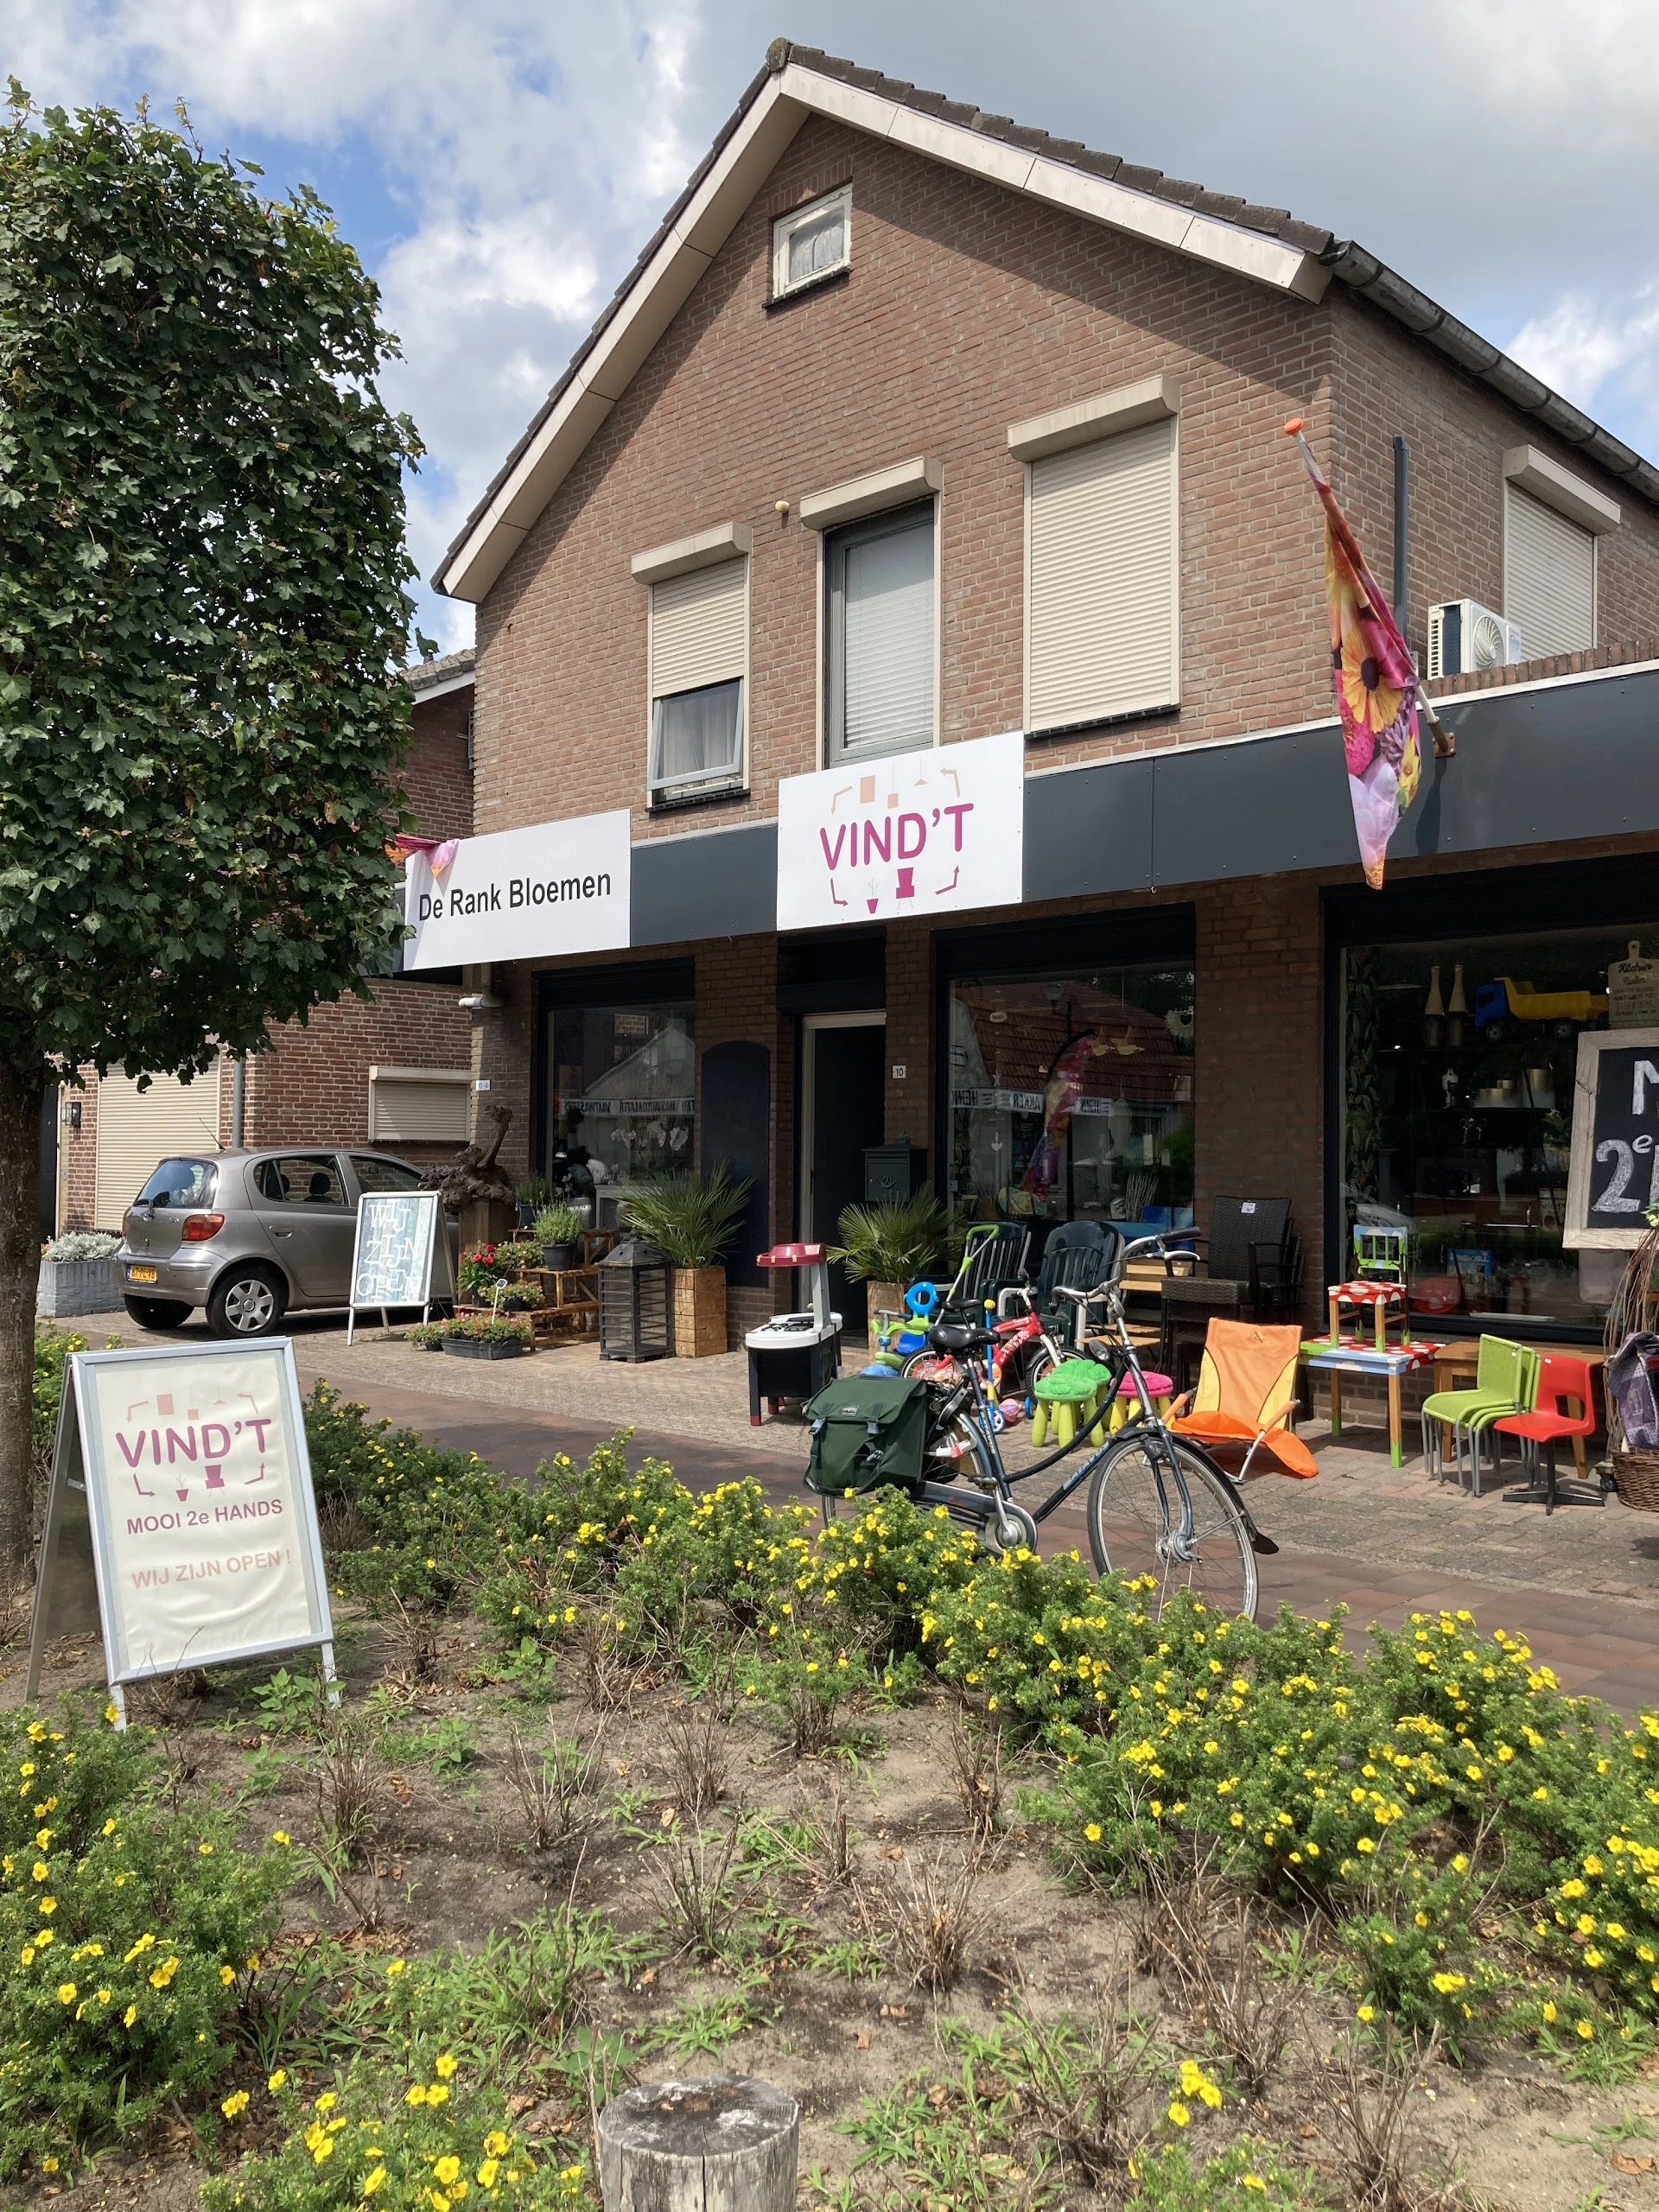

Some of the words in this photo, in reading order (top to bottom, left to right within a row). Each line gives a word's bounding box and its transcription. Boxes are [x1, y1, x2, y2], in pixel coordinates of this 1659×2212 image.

[819, 803, 974, 870] VIND'T
[419, 893, 443, 921] De
[450, 883, 502, 917] Rank
[510, 874, 611, 908] Bloemen
[896, 1067, 904, 1077] 10
[369, 1198, 411, 1232] WIJ
[365, 1234, 420, 1268] ZIJN
[356, 1269, 423, 1299] OPEN
[116, 1419, 271, 1468] VIND'T
[127, 1512, 181, 1535] MOOI
[187, 1510, 209, 1527] 2e
[215, 1498, 283, 1522] HANDS
[131, 1567, 169, 1589] WIJ
[175, 1560, 221, 1582] ZIJN
